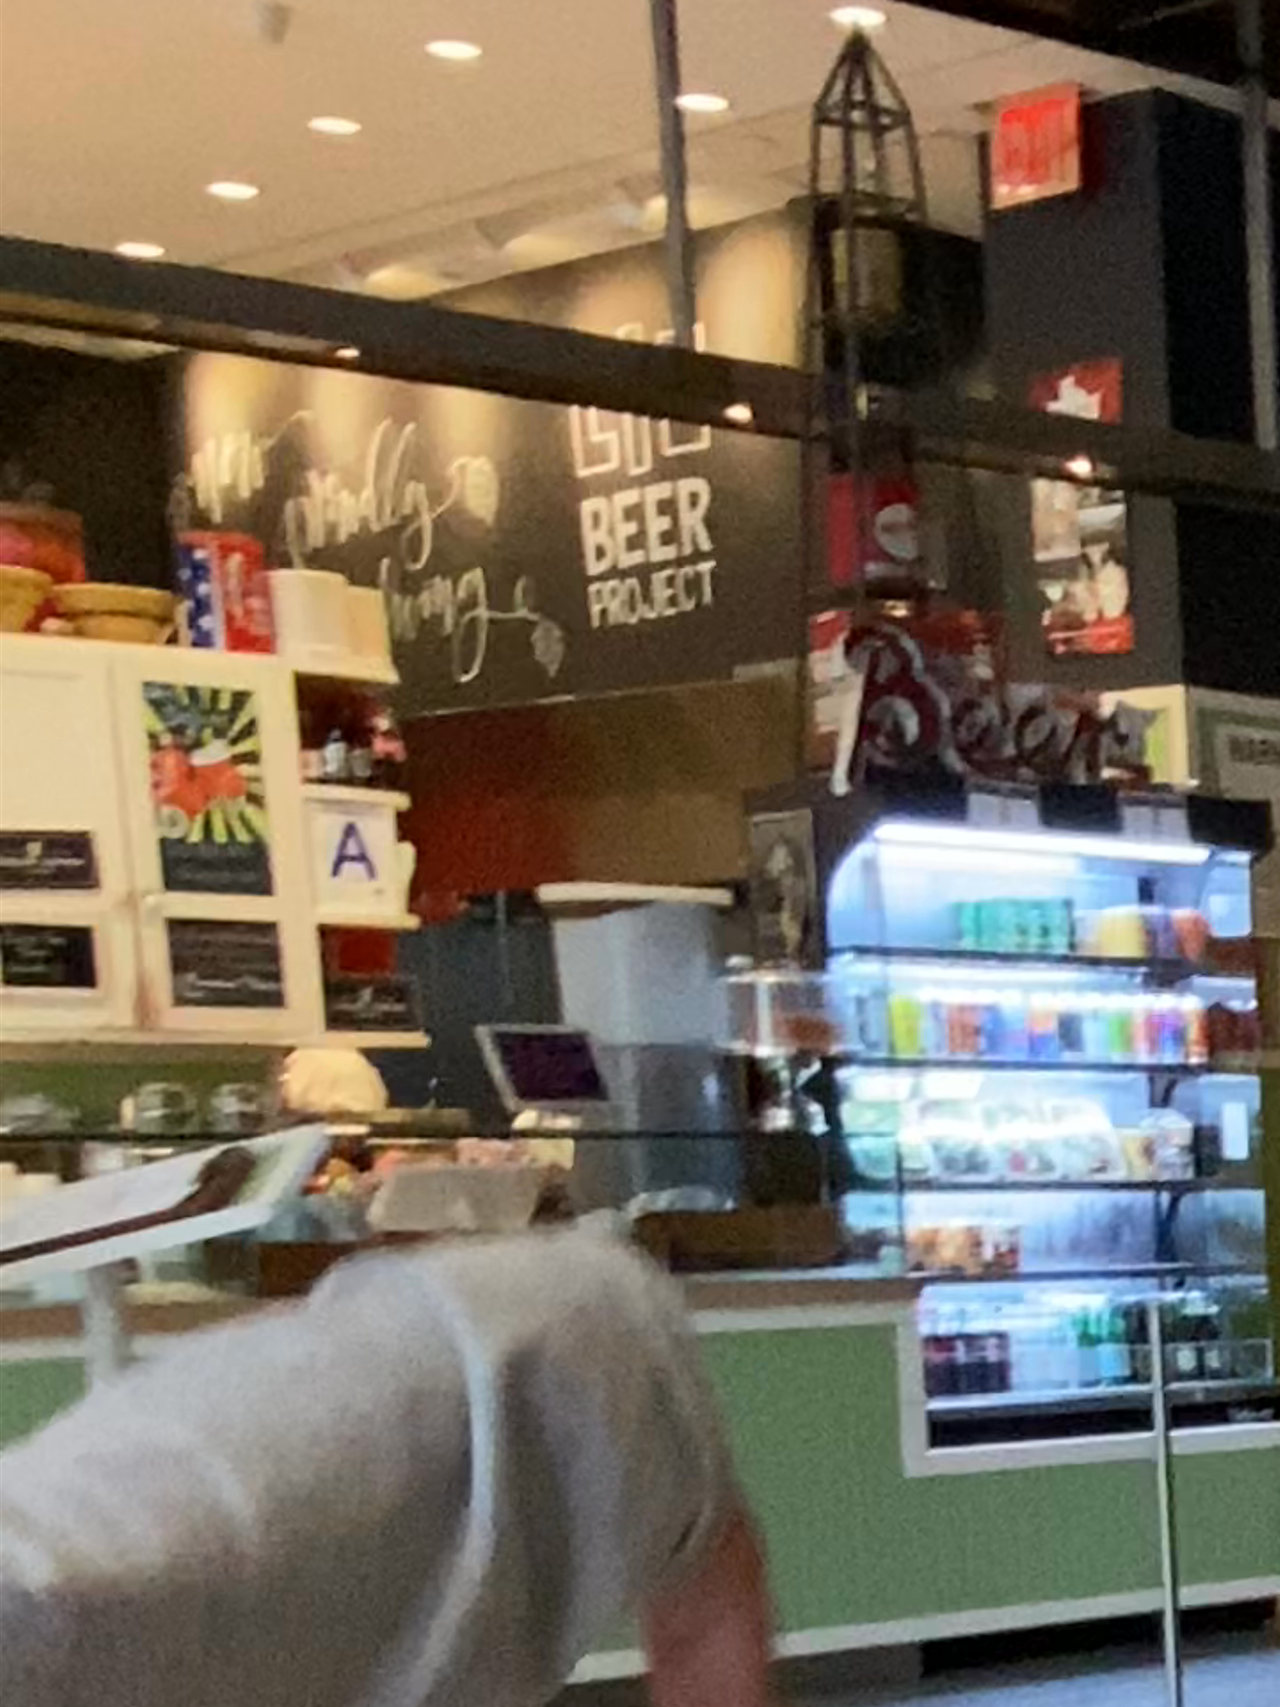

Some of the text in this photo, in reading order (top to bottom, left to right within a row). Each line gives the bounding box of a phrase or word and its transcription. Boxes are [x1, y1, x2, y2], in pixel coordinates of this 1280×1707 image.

[580, 476, 714, 576] BEER
[587, 560, 717, 629] PROJECT
[331, 821, 378, 881] A
